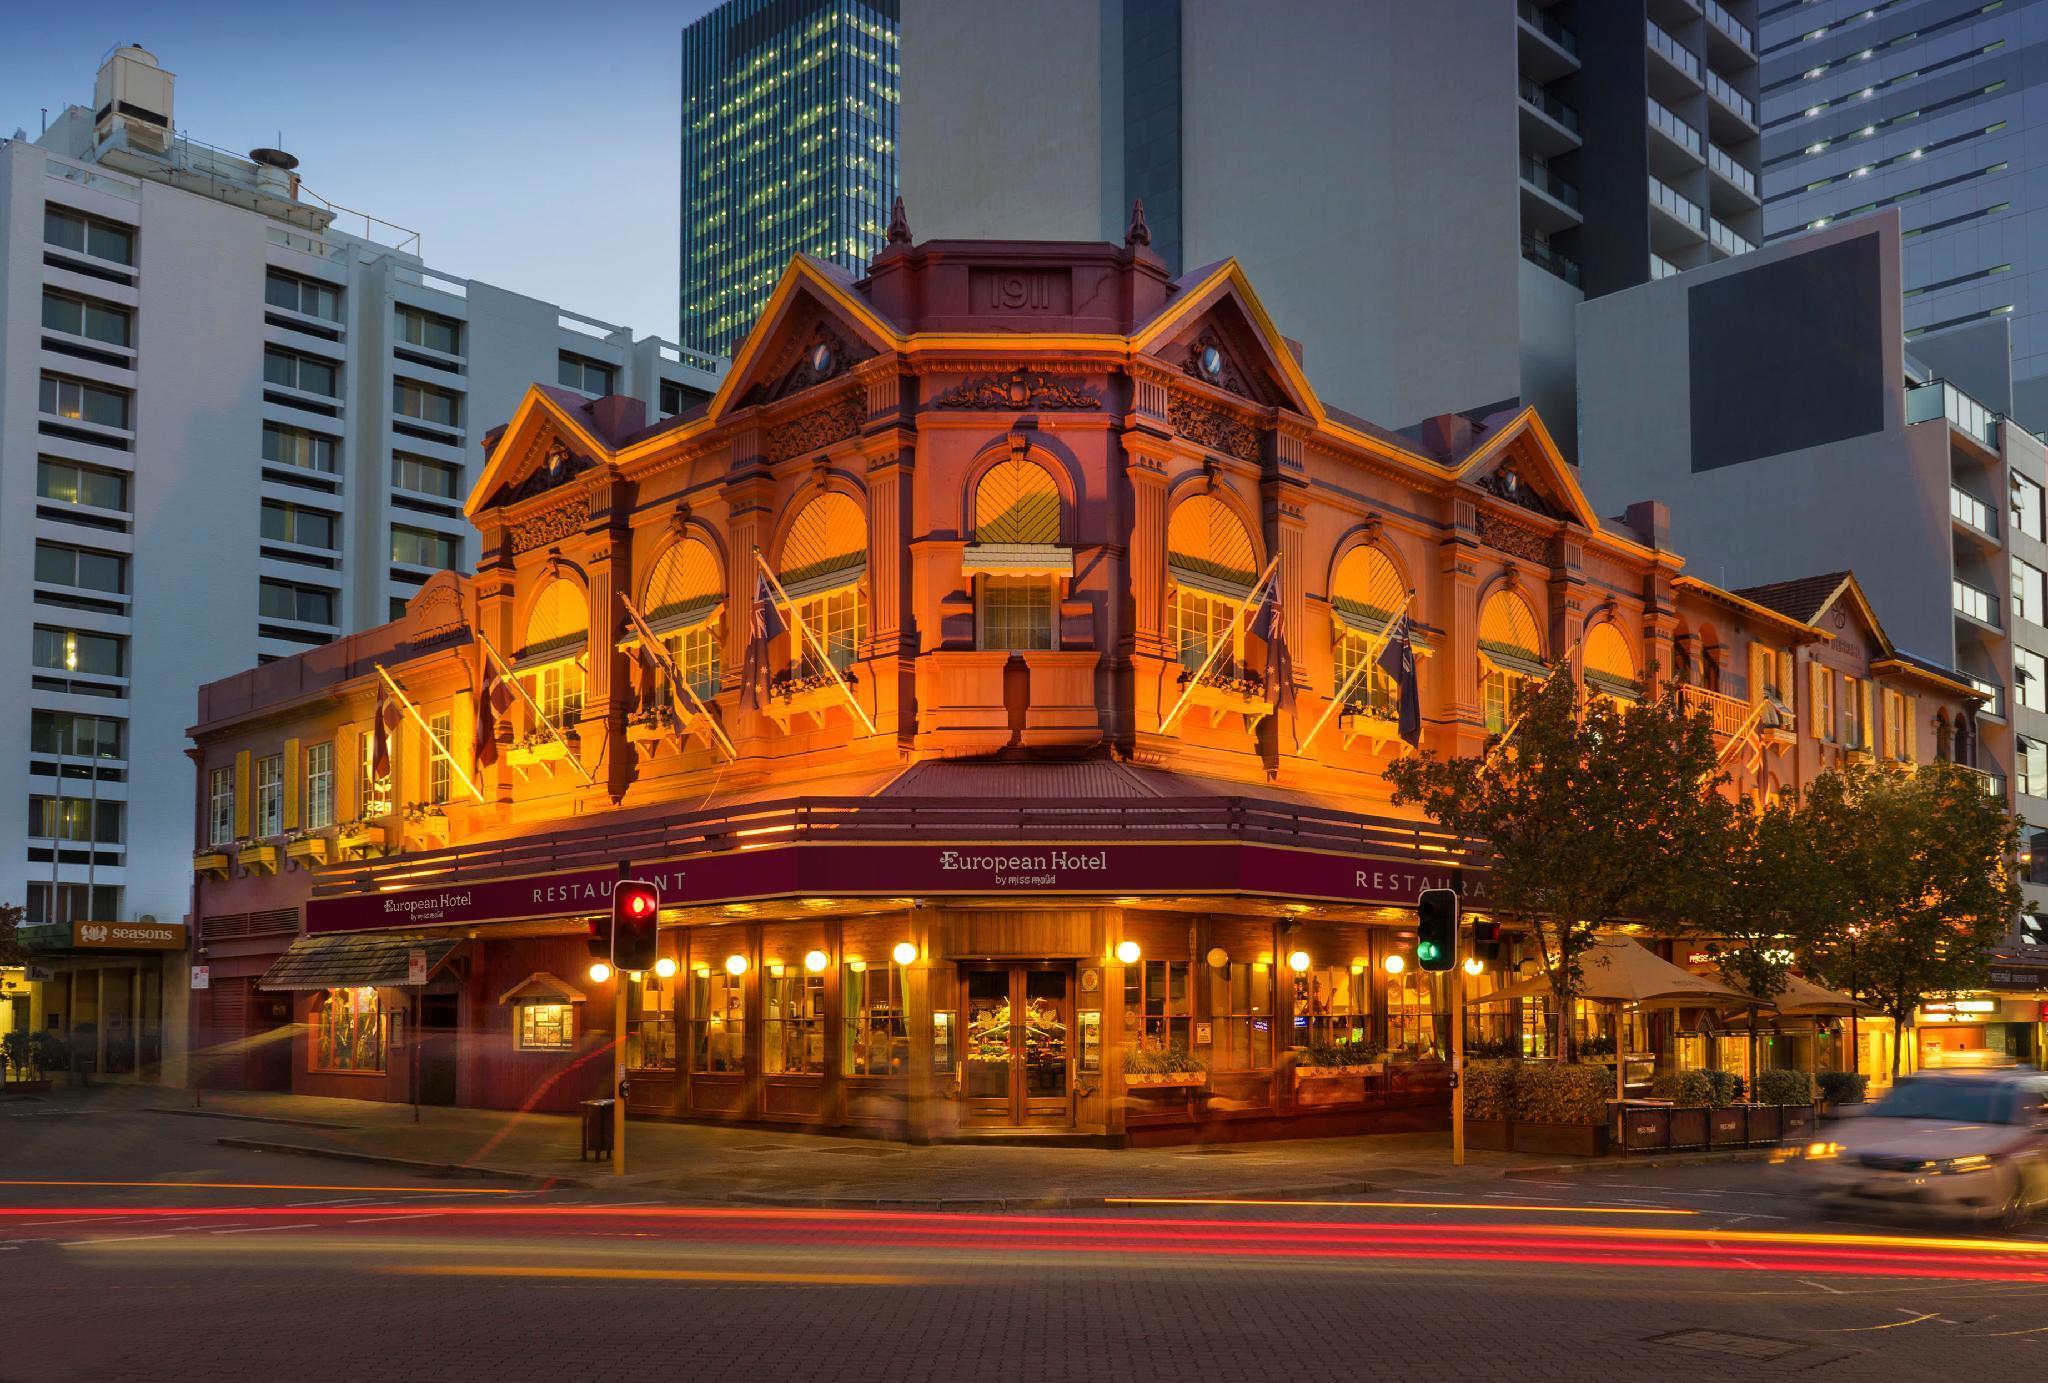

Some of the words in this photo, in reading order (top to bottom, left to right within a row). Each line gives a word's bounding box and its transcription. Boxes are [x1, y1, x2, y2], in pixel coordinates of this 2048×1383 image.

[991, 275, 1049, 310] 1911
[940, 851, 1047, 873] European
[1051, 851, 1107, 870] Hotel
[533, 872, 686, 903] RESTAUNT
[995, 874, 1007, 886] by
[1008, 875, 1031, 886] miss
[383, 897, 438, 912] European
[439, 891, 472, 907] Hotel
[111, 927, 174, 940] seasons
